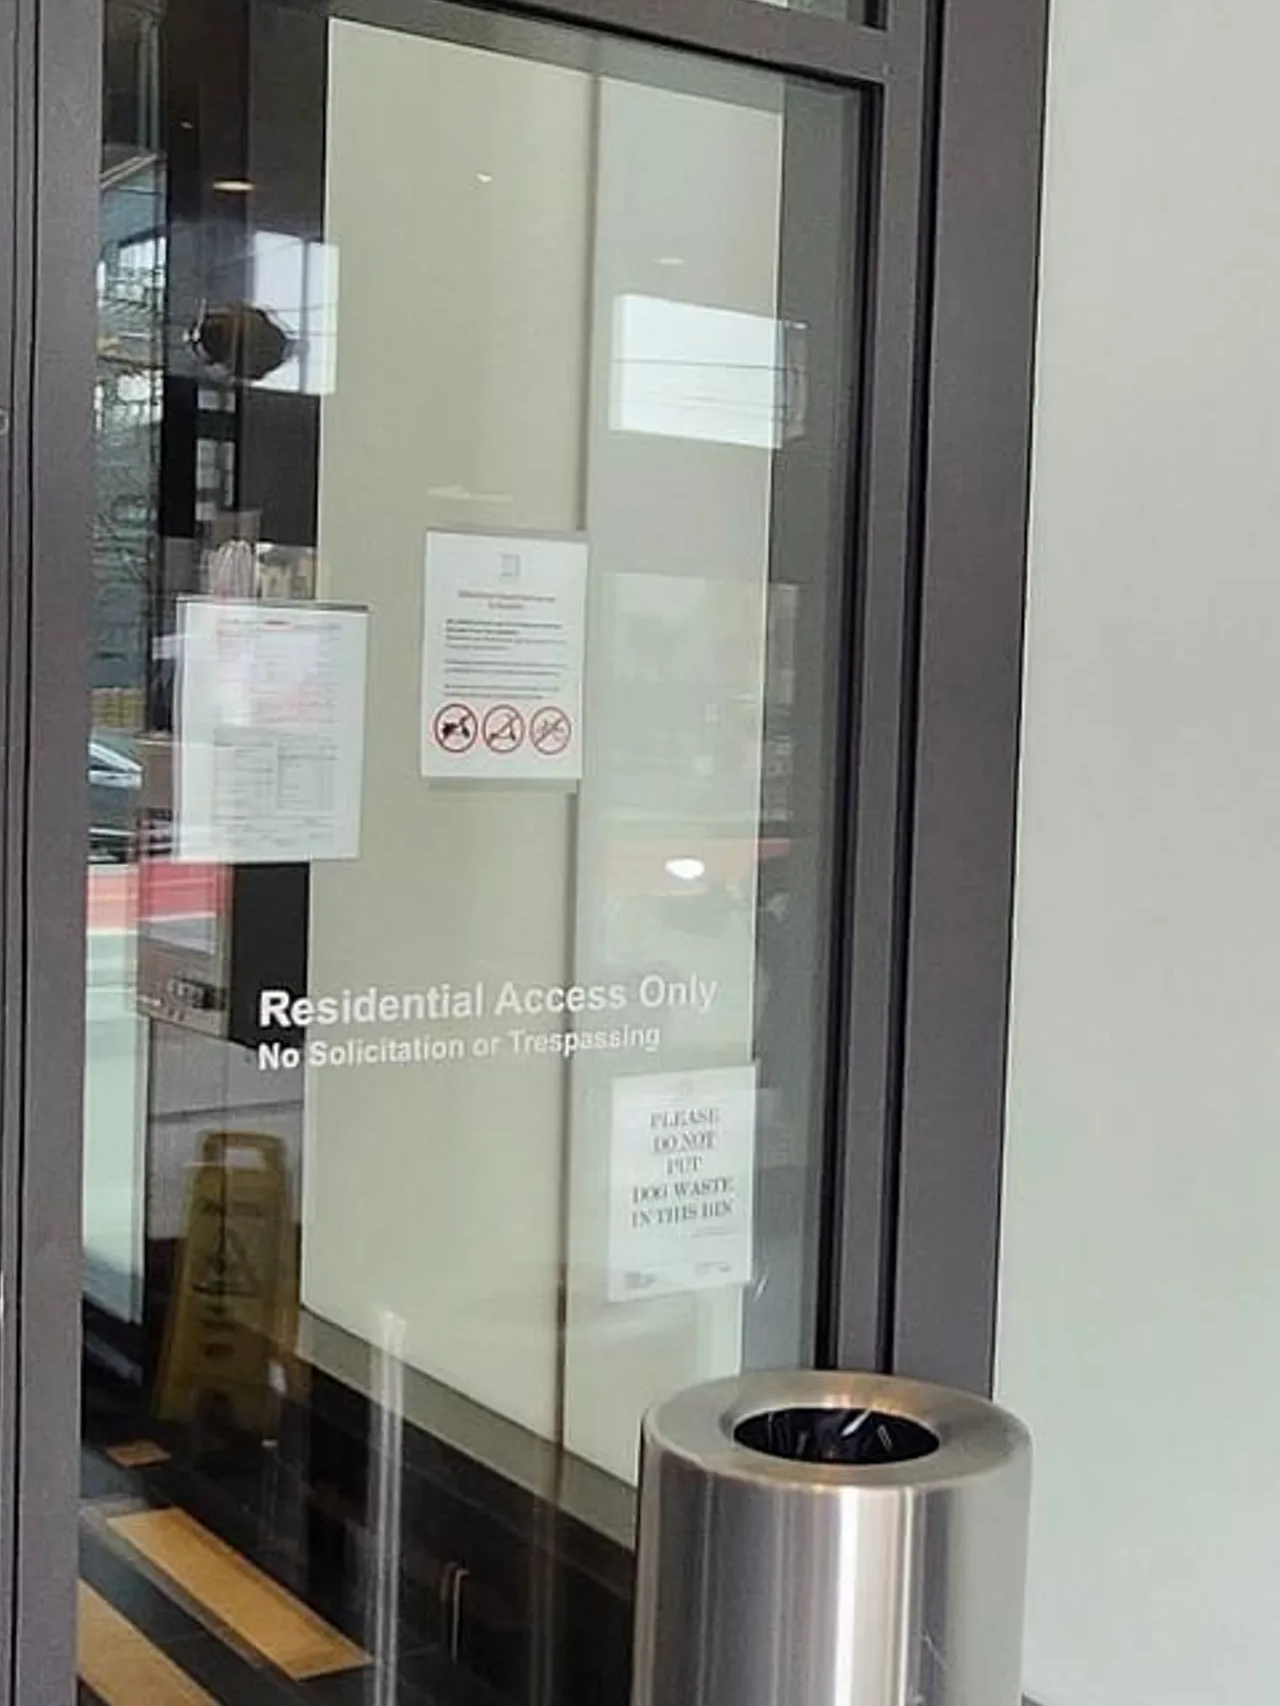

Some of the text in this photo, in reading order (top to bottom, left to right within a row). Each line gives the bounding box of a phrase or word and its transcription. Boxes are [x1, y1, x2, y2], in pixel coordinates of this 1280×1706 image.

[258, 973, 719, 1027] Residential Access Only
[257, 1026, 661, 1071] No Solicitation or Trespassing
[649, 1107, 719, 1130] PLEASE
[652, 1130, 715, 1154] DO NOT
[665, 1155, 703, 1175] PUT
[631, 1176, 735, 1205] DOG WASTE
[630, 1200, 734, 1230] IN THIS BIN
